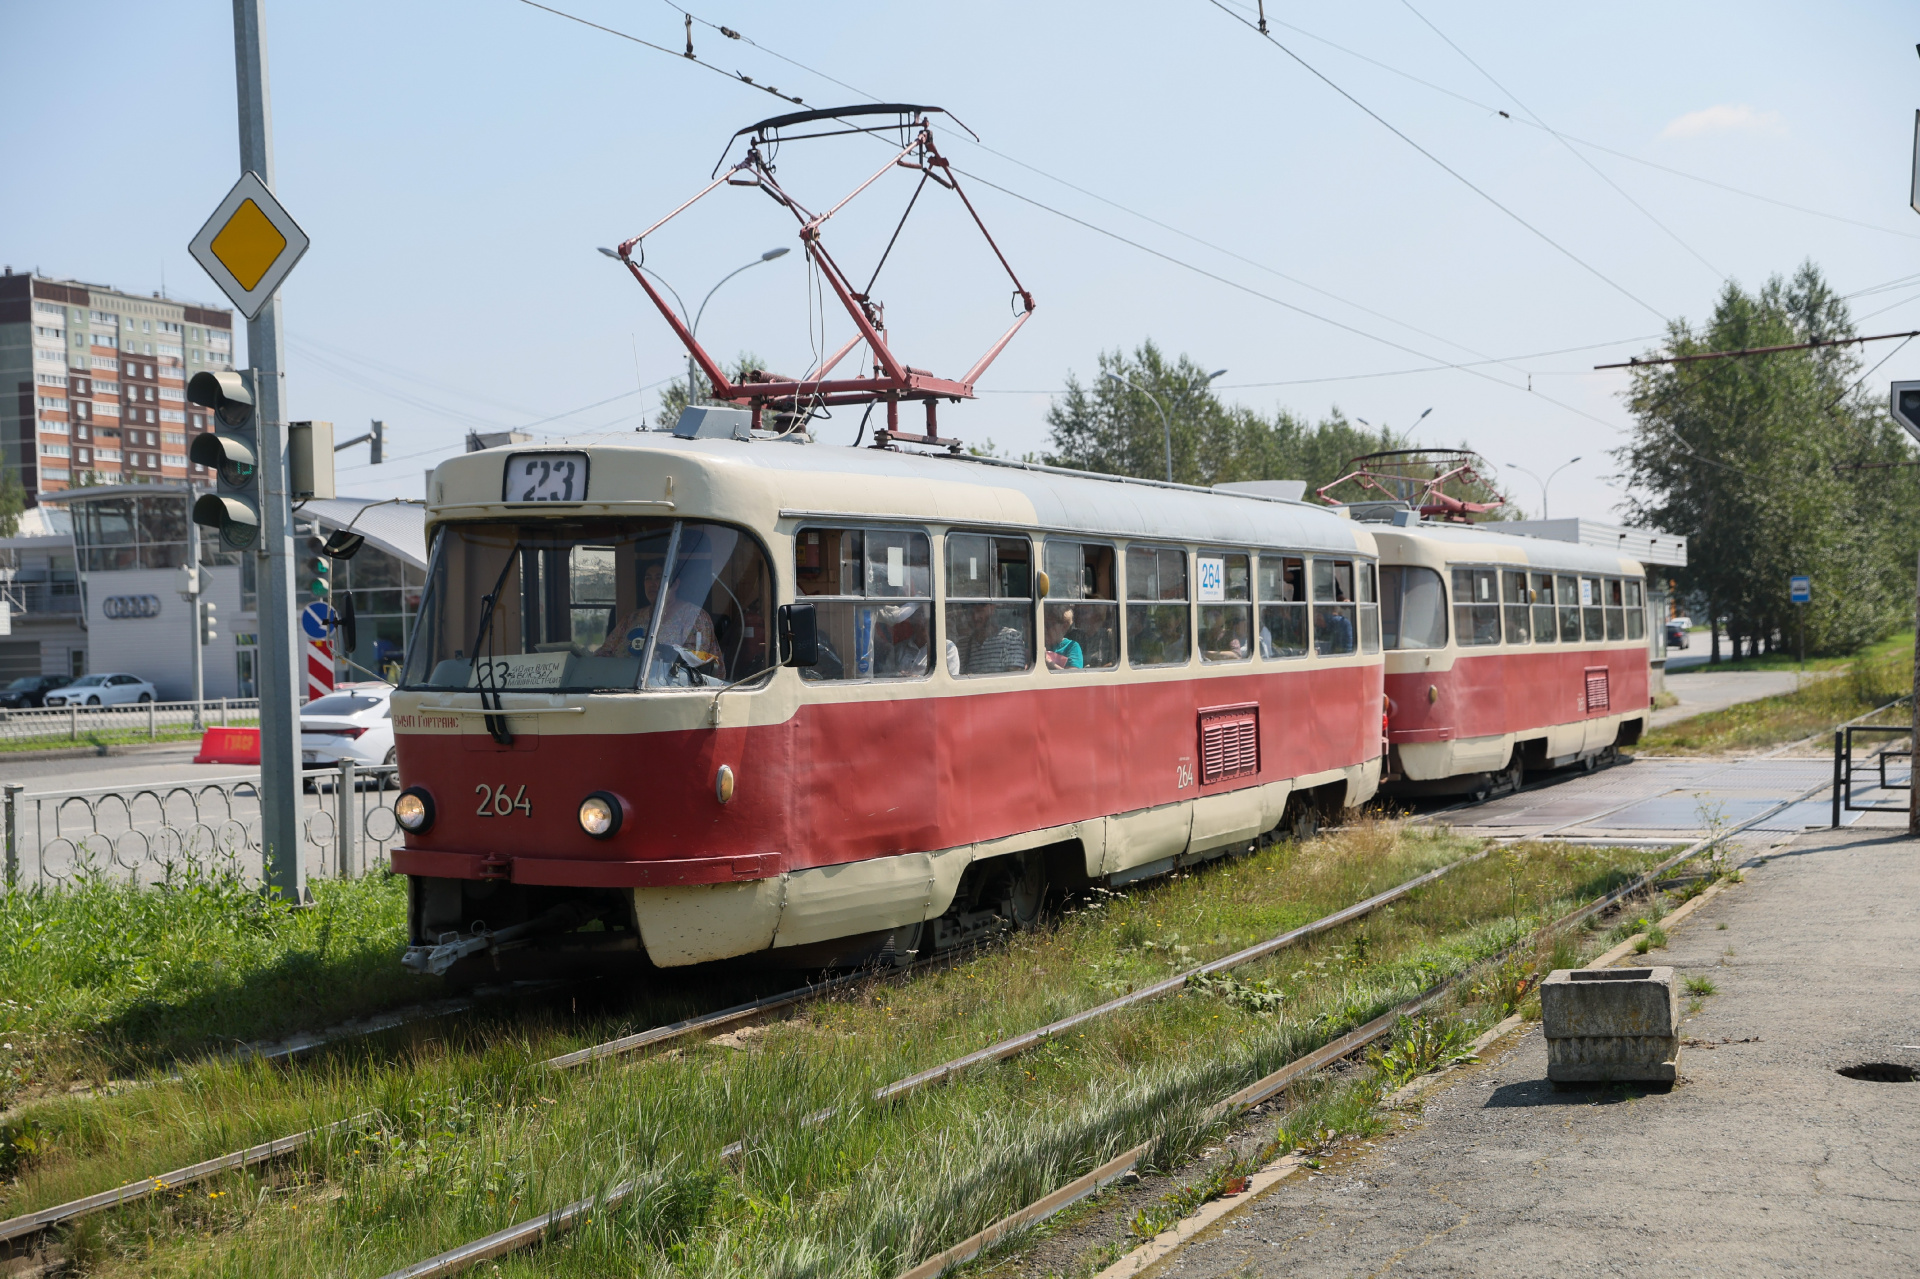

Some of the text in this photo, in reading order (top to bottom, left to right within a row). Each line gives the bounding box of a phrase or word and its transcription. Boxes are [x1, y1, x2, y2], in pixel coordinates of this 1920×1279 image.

[523, 461, 575, 502] 23
[1202, 563, 1220, 589] 264
[474, 662, 510, 688] 23
[394, 715, 415, 728] ЕМУП
[1176, 763, 1193, 789] 264
[475, 783, 532, 817] 264
